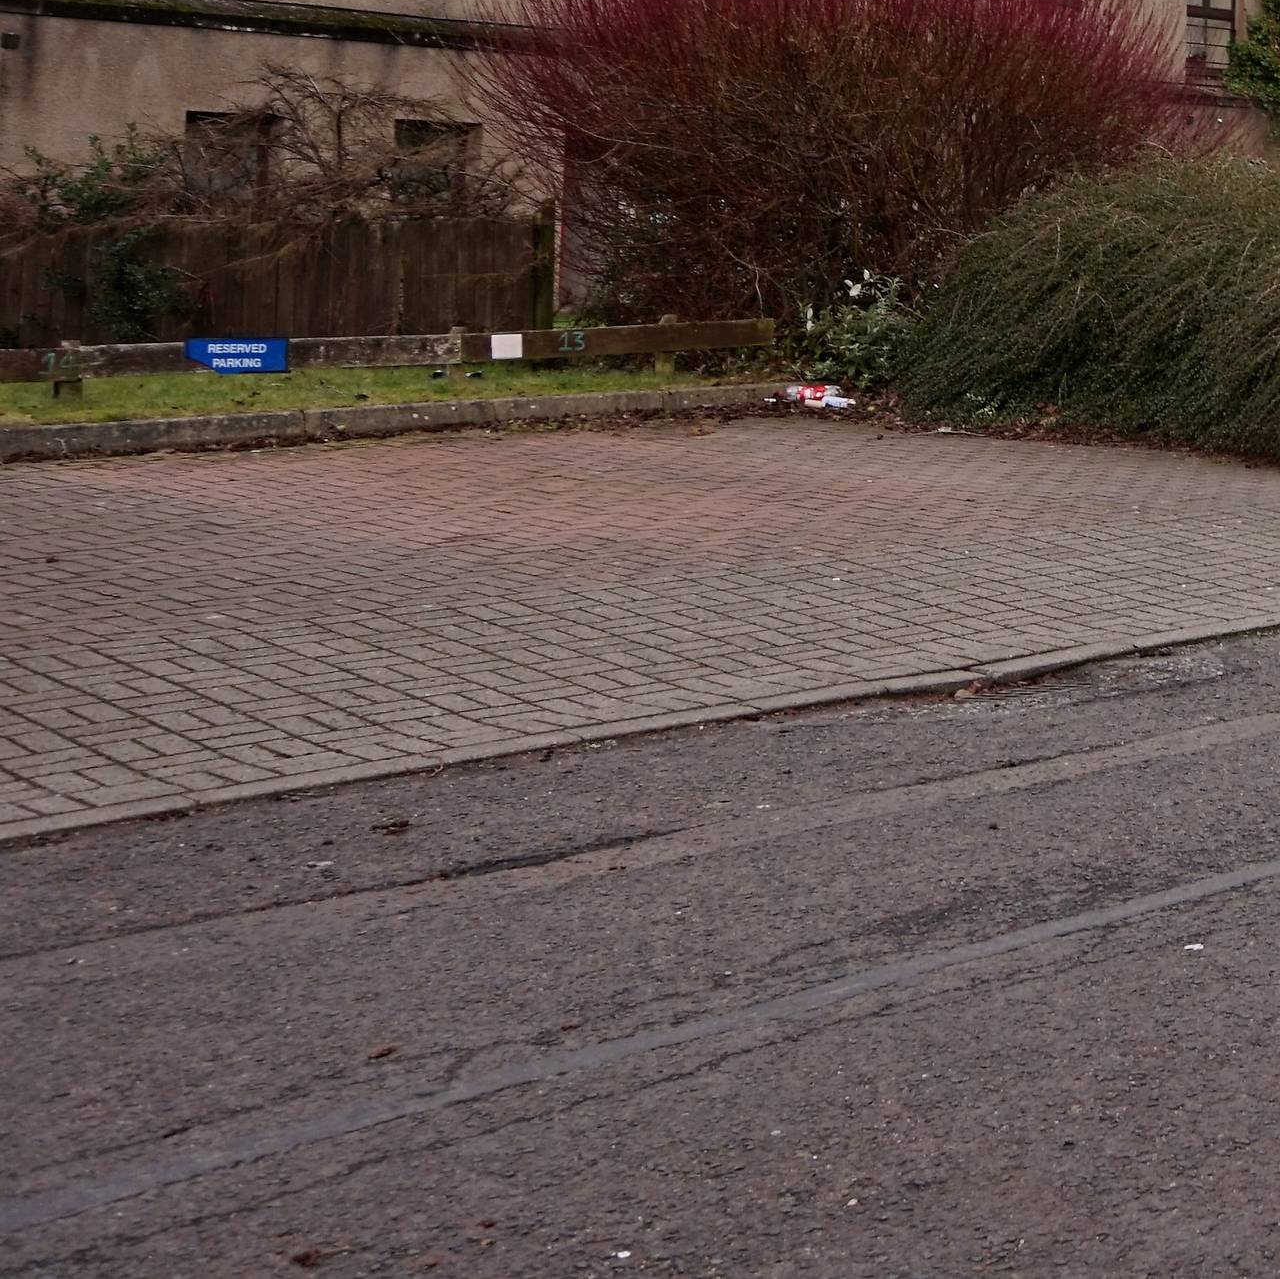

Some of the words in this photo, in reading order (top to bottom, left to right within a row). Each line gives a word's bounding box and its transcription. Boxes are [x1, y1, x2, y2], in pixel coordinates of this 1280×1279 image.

[559, 331, 585, 351] 13
[207, 343, 267, 354] RESERVED
[212, 358, 262, 368] PARKING
